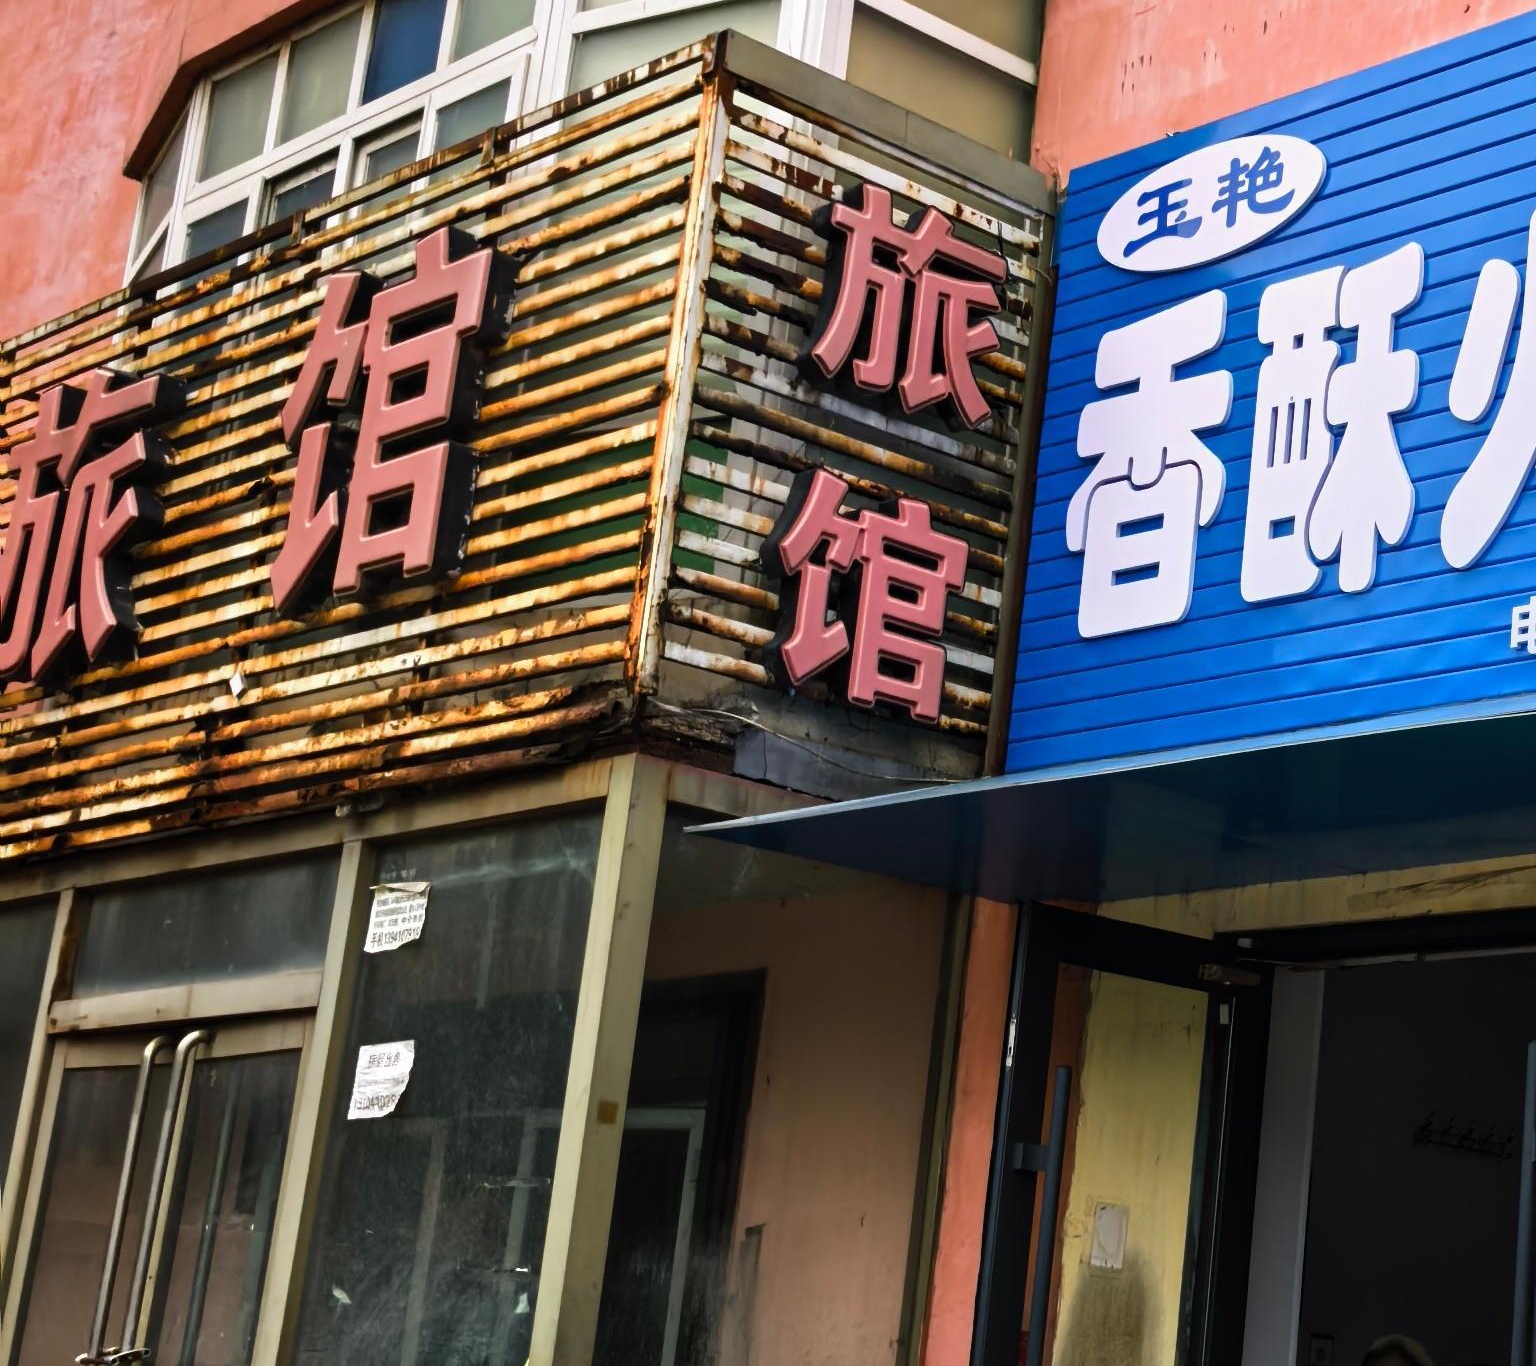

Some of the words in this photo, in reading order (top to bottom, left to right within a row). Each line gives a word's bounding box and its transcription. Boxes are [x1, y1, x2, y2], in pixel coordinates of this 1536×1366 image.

[1122, 145, 1297, 259] 玉艳
[0, 225, 497, 687] 旅馆
[780, 181, 1008, 726] 旅馆
